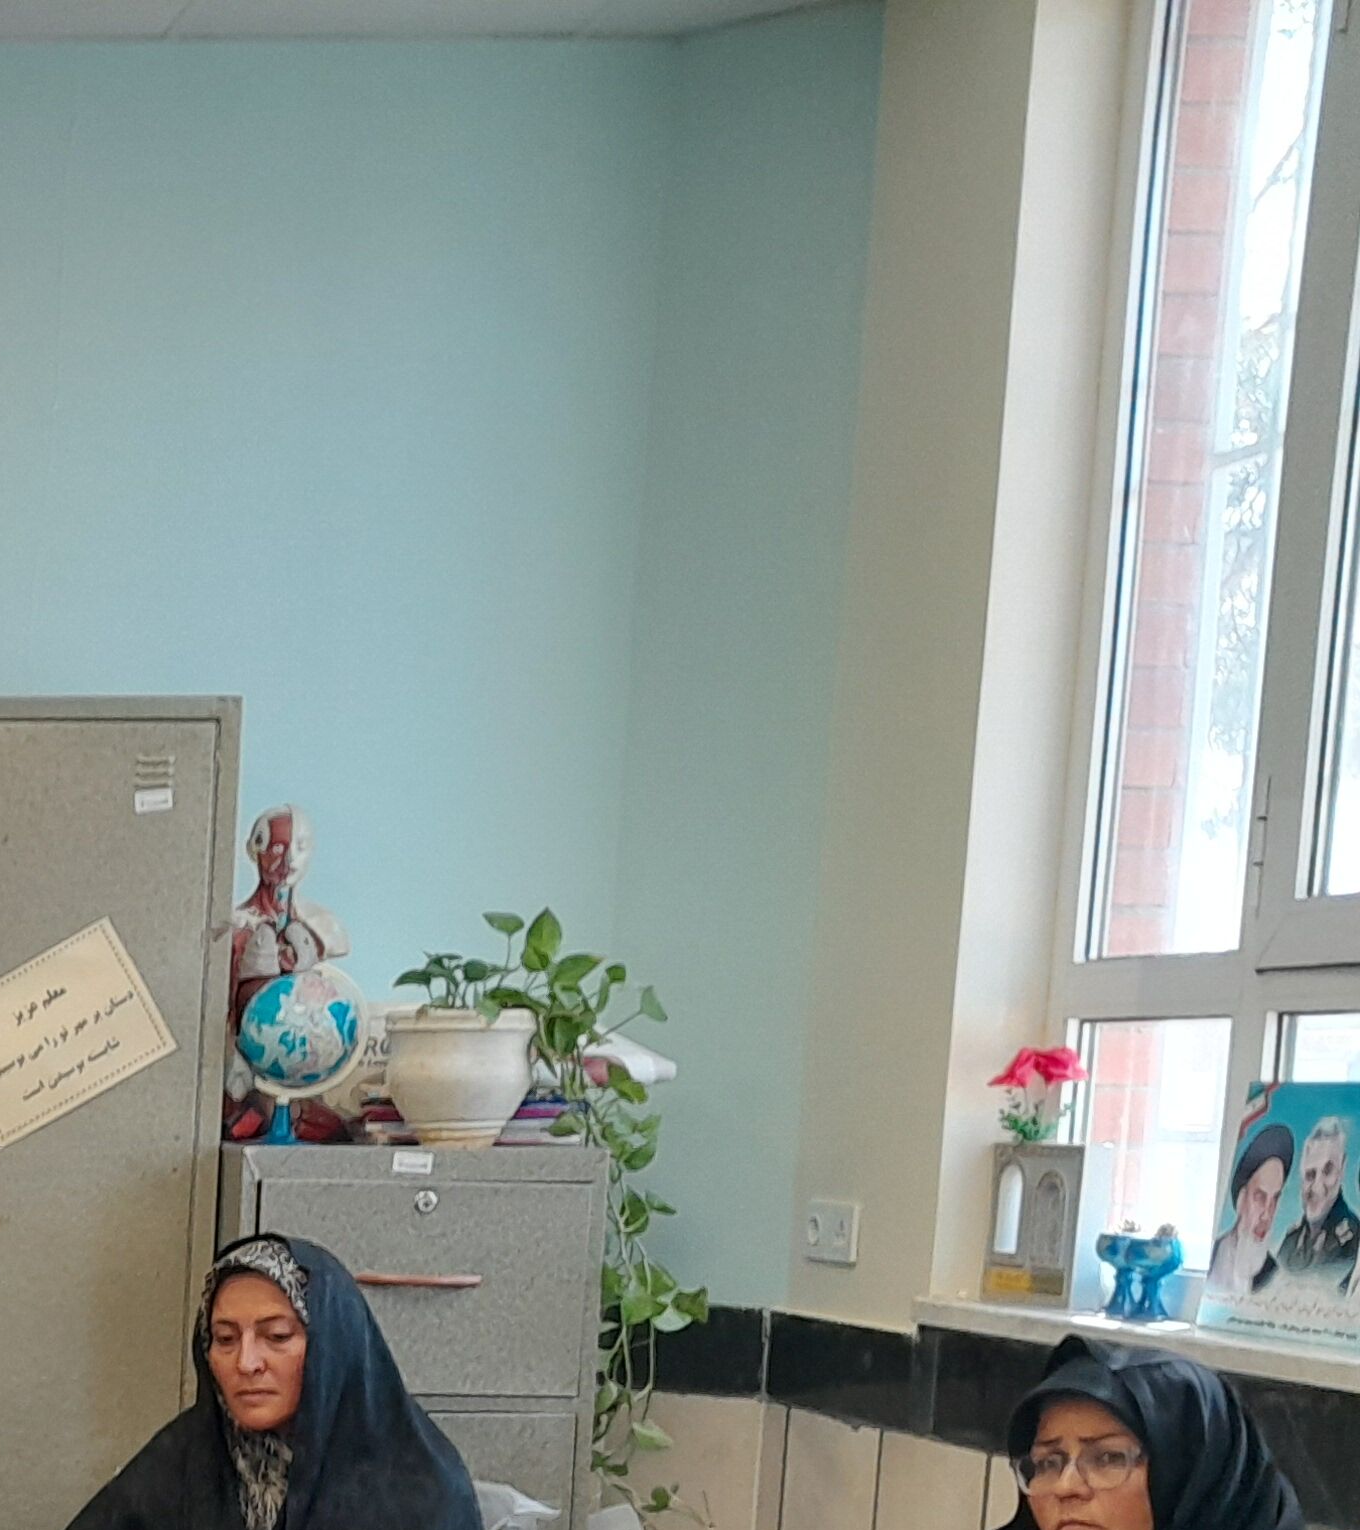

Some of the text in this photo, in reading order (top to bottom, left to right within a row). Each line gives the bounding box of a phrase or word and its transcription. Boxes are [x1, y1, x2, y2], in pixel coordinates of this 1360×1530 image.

[12, 987, 67, 1026] معلم عزیز
[104, 990, 134, 1017] دستان
[73, 1018, 88, 1036] مهر
[22, 1079, 45, 1102] است
